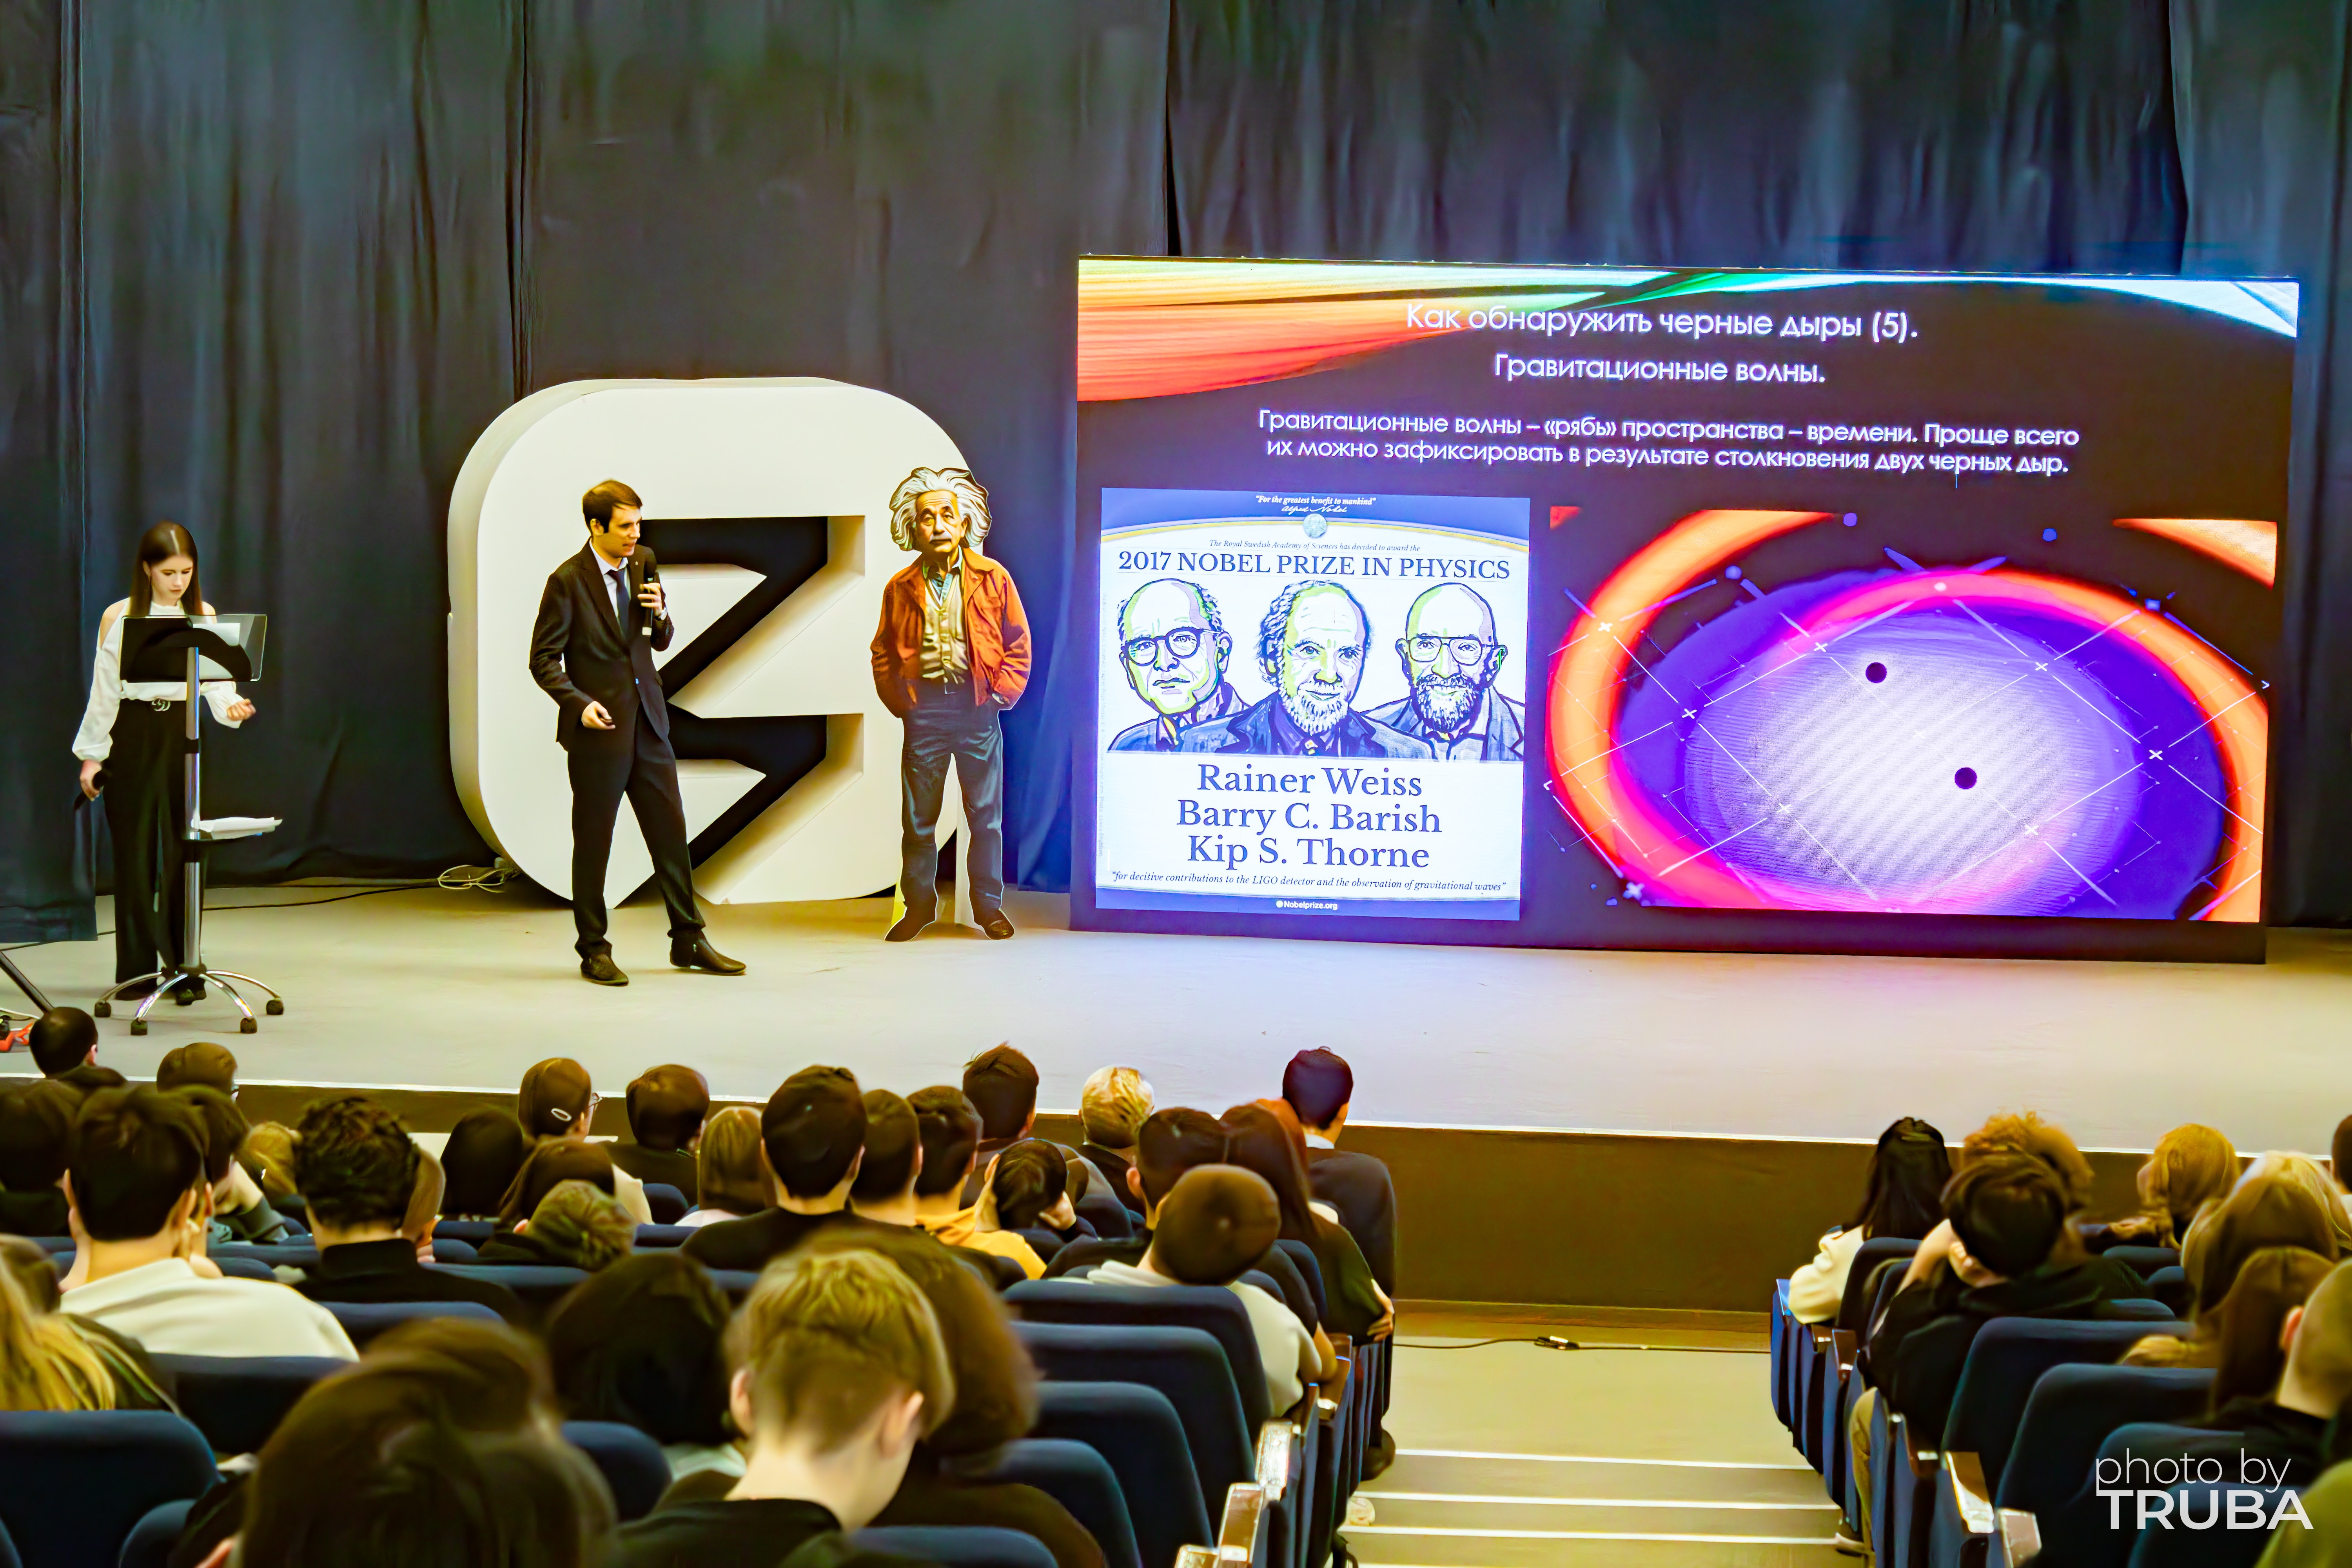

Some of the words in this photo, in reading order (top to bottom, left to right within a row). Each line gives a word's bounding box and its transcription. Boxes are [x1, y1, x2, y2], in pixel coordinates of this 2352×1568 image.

[1407, 303, 1461, 328] Как
[1469, 305, 1652, 337] обнаружить
[1660, 314, 1773, 339] черные
[1780, 316, 1862, 341] дыры
[1873, 312, 1918, 343] (5).
[1495, 353, 1728, 381] Гравитационные
[1736, 363, 1825, 382] волны.
[1259, 409, 1448, 433] Гравитационные
[1455, 418, 1521, 434] волны
[1544, 417, 1617, 439] «рябь»
[1622, 422, 1783, 442] пространства
[1808, 425, 1918, 444] времени.
[1924, 424, 2009, 447] Проще
[2014, 429, 2079, 445] всего
[1267, 441, 1293, 456] их
[1298, 441, 1378, 457] можно
[1384, 439, 1563, 465] зафиксировать
[1569, 450, 1579, 462] в
[1586, 448, 1708, 467] результате
[1715, 450, 1869, 468] столкновения
[1875, 454, 1924, 473] двух
[1929, 455, 2012, 475] черных
[2016, 457, 2068, 476] дыр.
[1311, 497, 1333, 505] benefit
[1224, 540, 1242, 548] Royal
[1119, 551, 1171, 570] 2017
[1178, 553, 1270, 573] NOBEL
[1277, 555, 1354, 575] PRIZE
[1362, 558, 1392, 576] IN
[1399, 559, 1510, 579] PHYSICS
[1197, 763, 1315, 793] Rainer
[1321, 767, 1422, 797] Weiss
[1177, 799, 1277, 835] Barry
[1285, 803, 1318, 829] C.
[1329, 803, 1442, 833] Barish
[1187, 834, 1248, 871] Kip
[1259, 837, 1287, 864] S.
[1297, 838, 1429, 867] Thorne
[1130, 872, 1163, 881] decisive
[1166, 873, 1223, 883] contributions
[1236, 875, 1250, 884] the
[1252, 876, 1278, 884] LIGO
[1280, 876, 1315, 885] detector
[1317, 878, 1333, 886] and
[1336, 878, 1348, 886] the
[1352, 878, 1401, 887] observation
[1404, 880, 1415, 890] of
[1414, 880, 1472, 891] gravitational
[1284, 900, 1338, 911] Nobelprize.org
